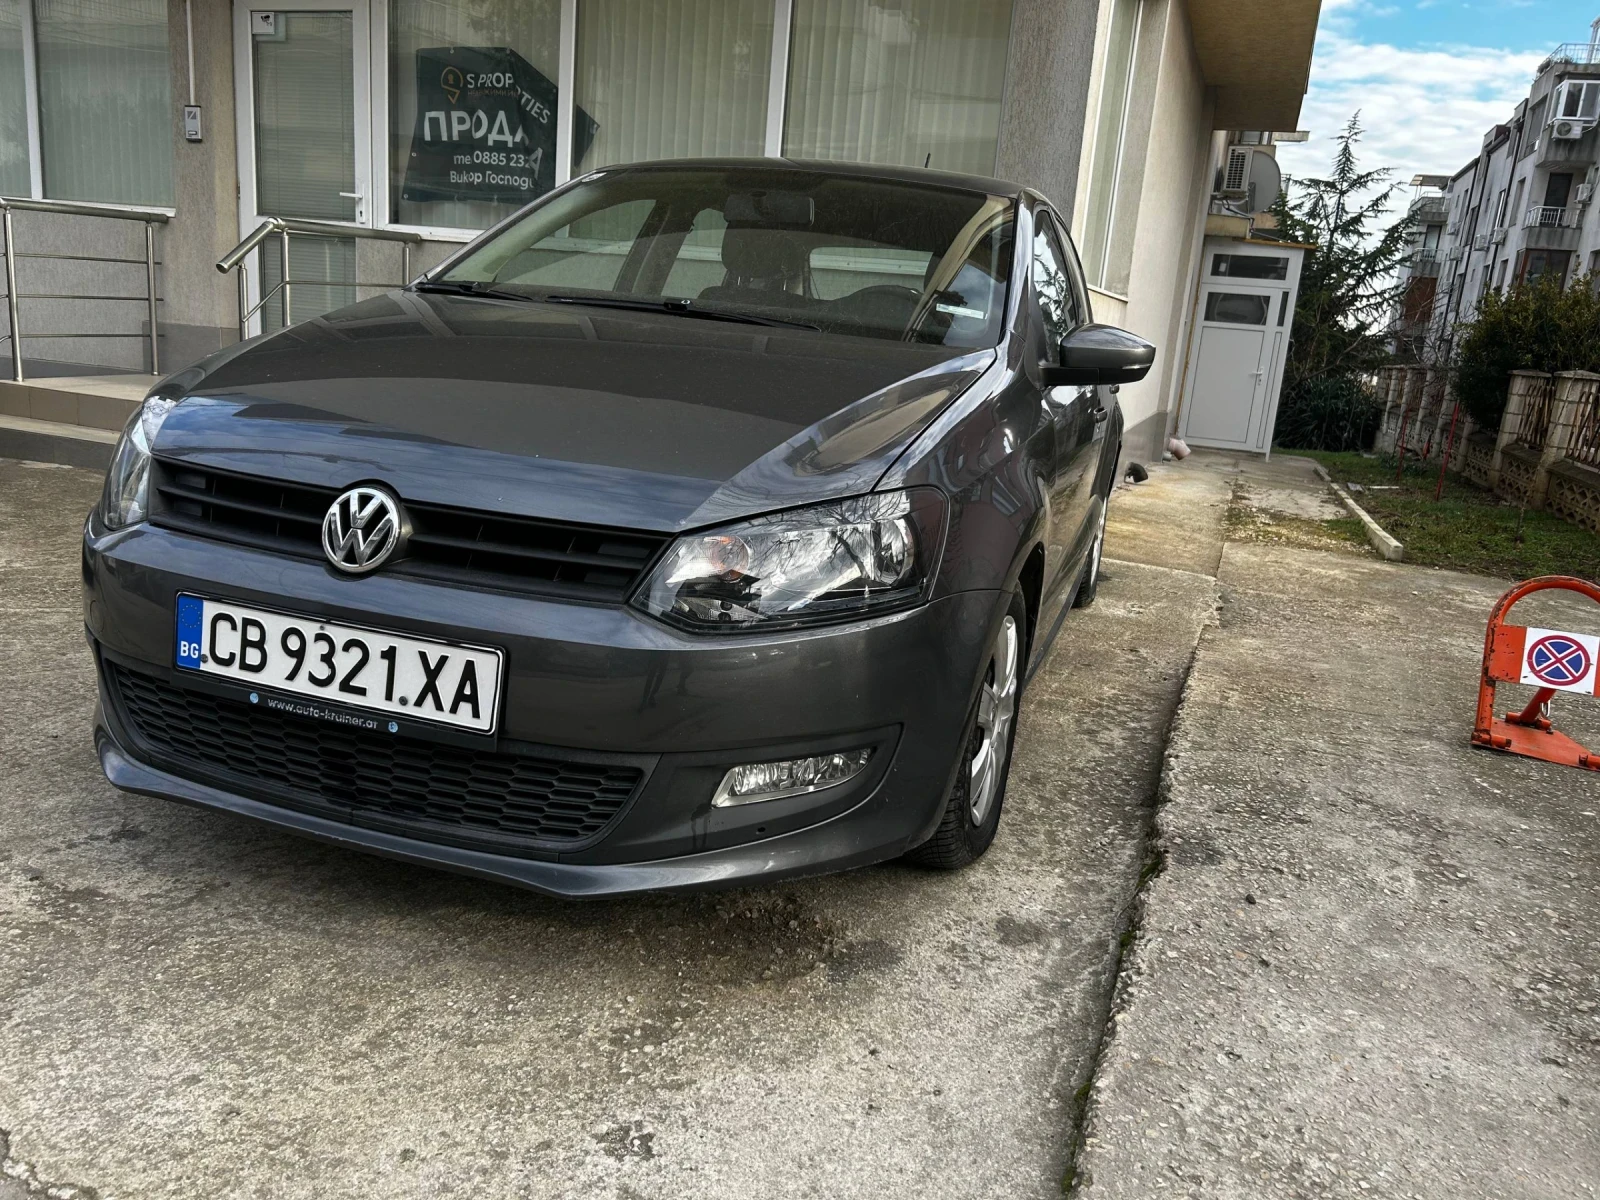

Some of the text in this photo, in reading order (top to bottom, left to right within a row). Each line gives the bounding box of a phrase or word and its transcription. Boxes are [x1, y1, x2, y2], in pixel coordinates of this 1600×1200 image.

[466, 73, 475, 88] S
[473, 150, 506, 166] 0885
[180, 640, 200, 659] BG
[280, 626, 397, 702] 9321
